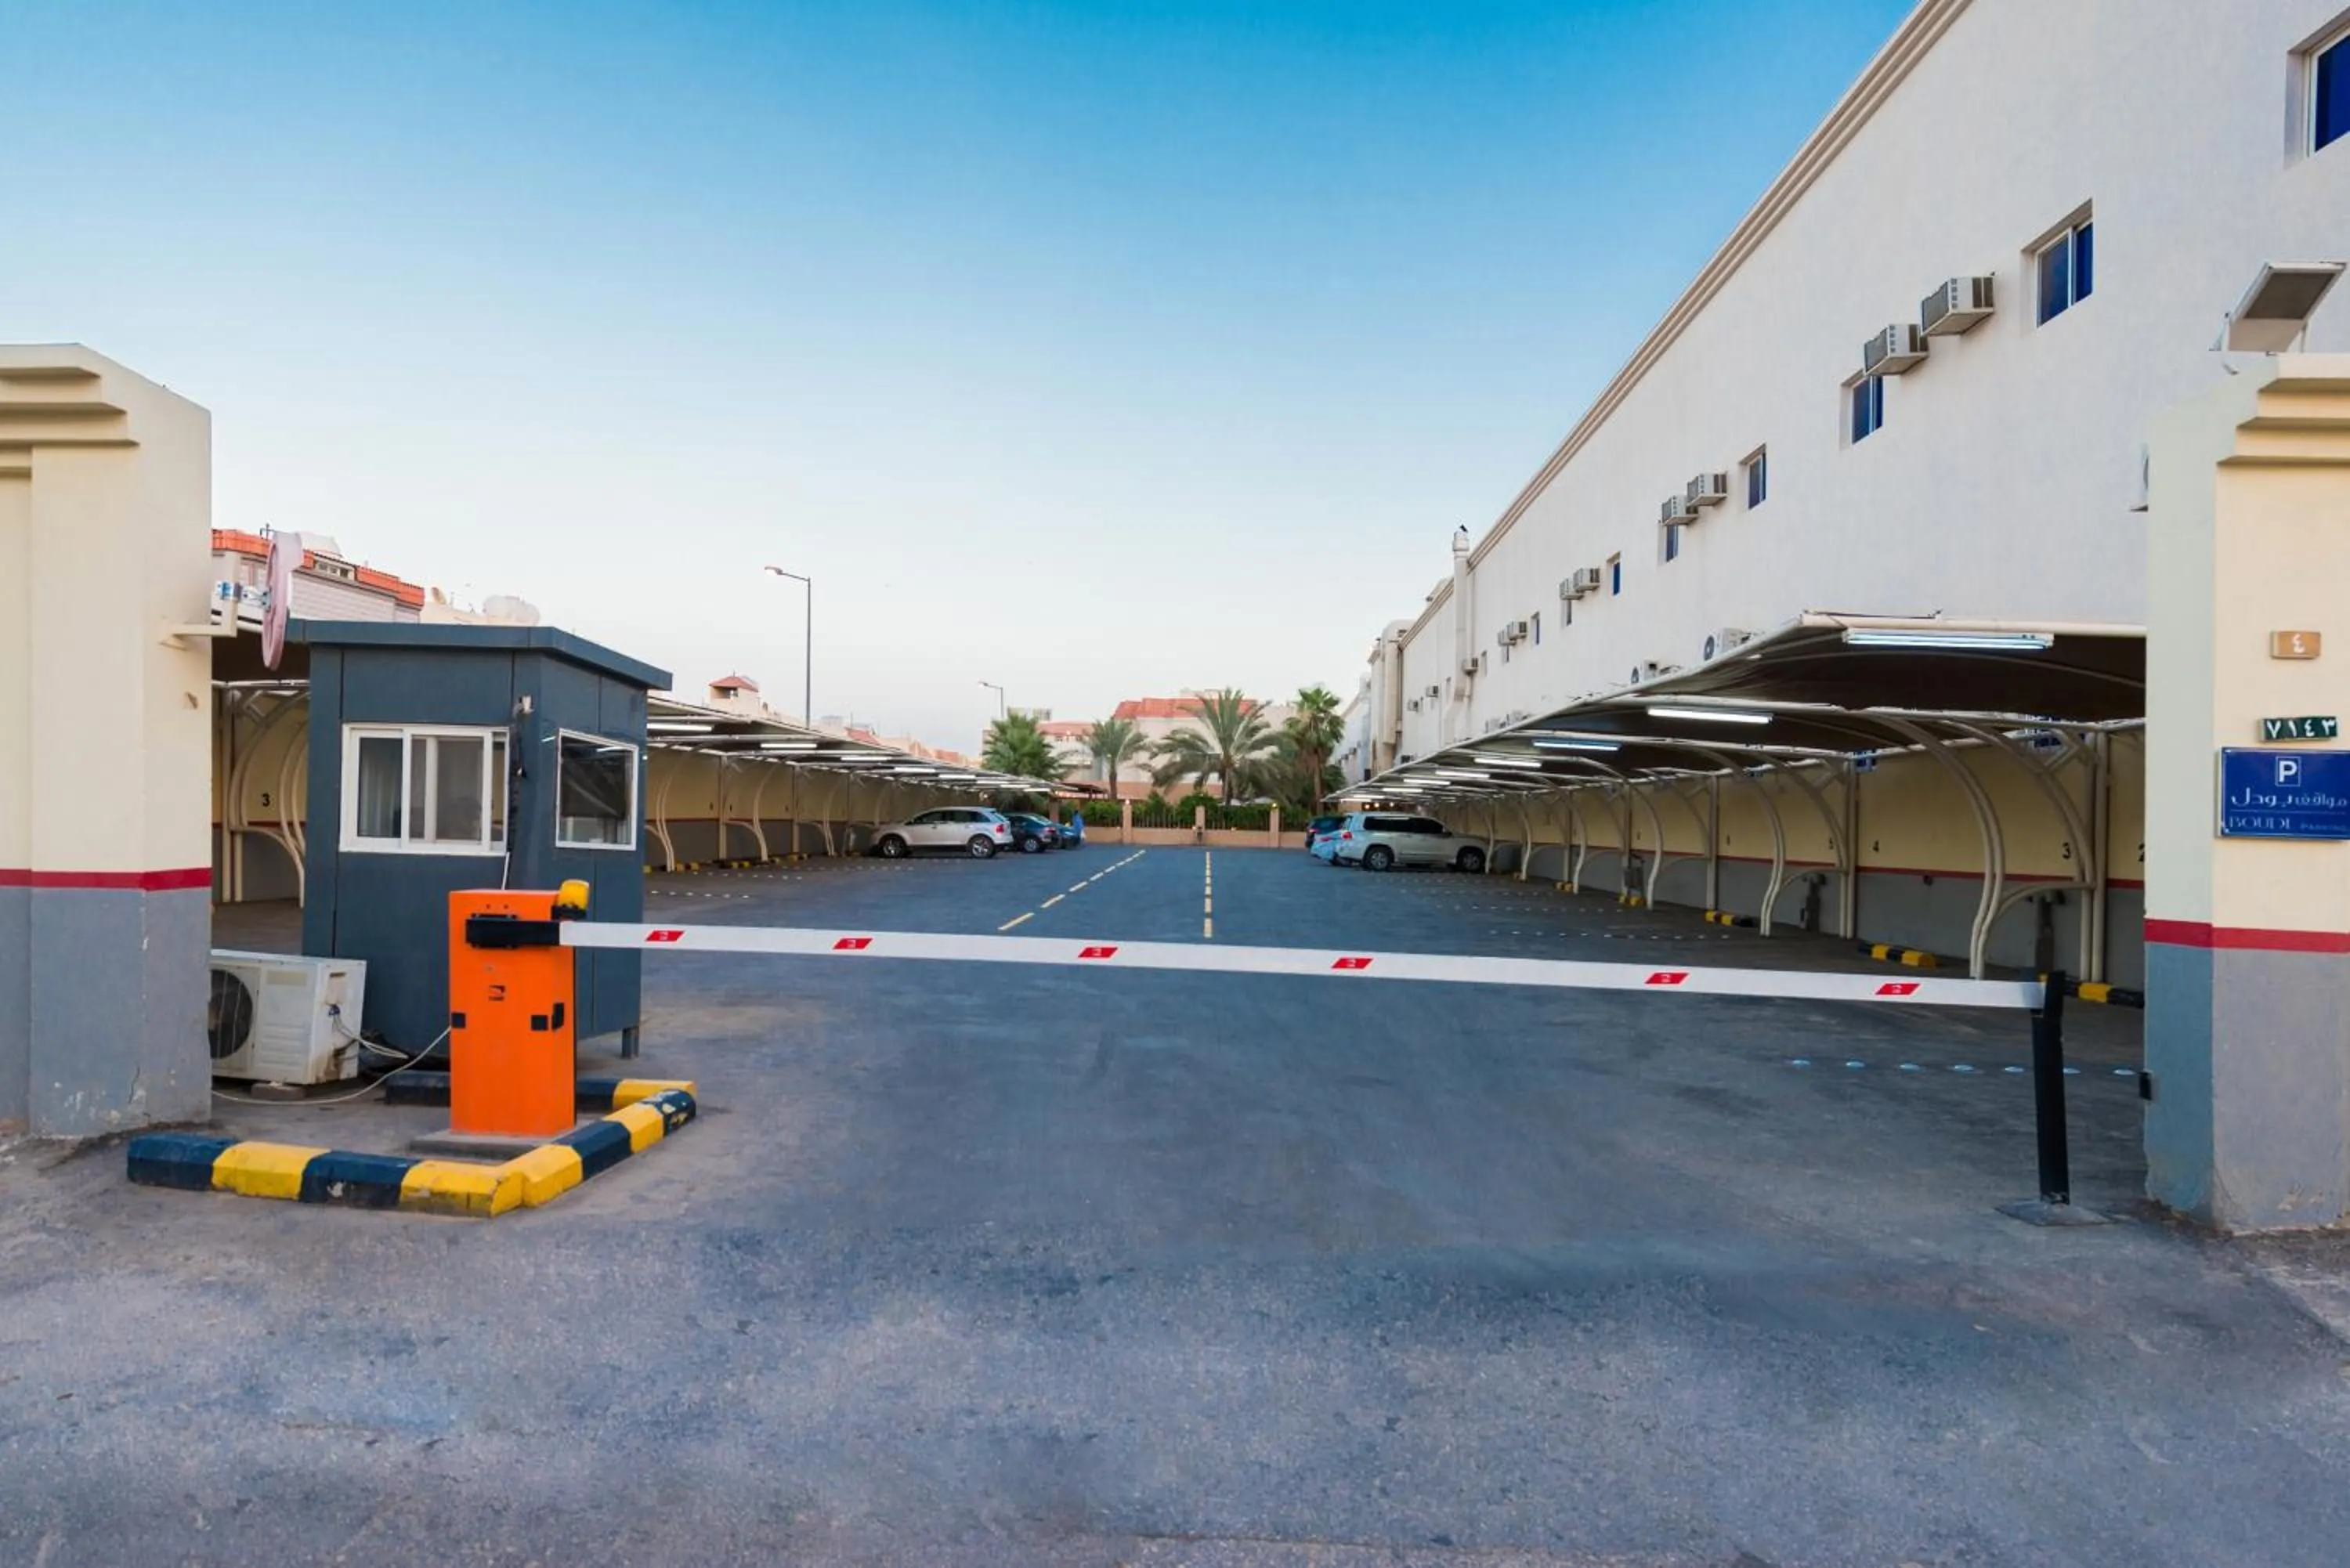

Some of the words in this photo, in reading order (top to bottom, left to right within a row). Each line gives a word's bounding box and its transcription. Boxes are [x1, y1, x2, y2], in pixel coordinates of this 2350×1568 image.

[2293, 633, 2305, 654] ٤
[2266, 719, 2335, 739] ٧١٤٣
[2278, 761, 2298, 782] P
[262, 793, 270, 807] 3
[2062, 842, 2071, 860] 3
